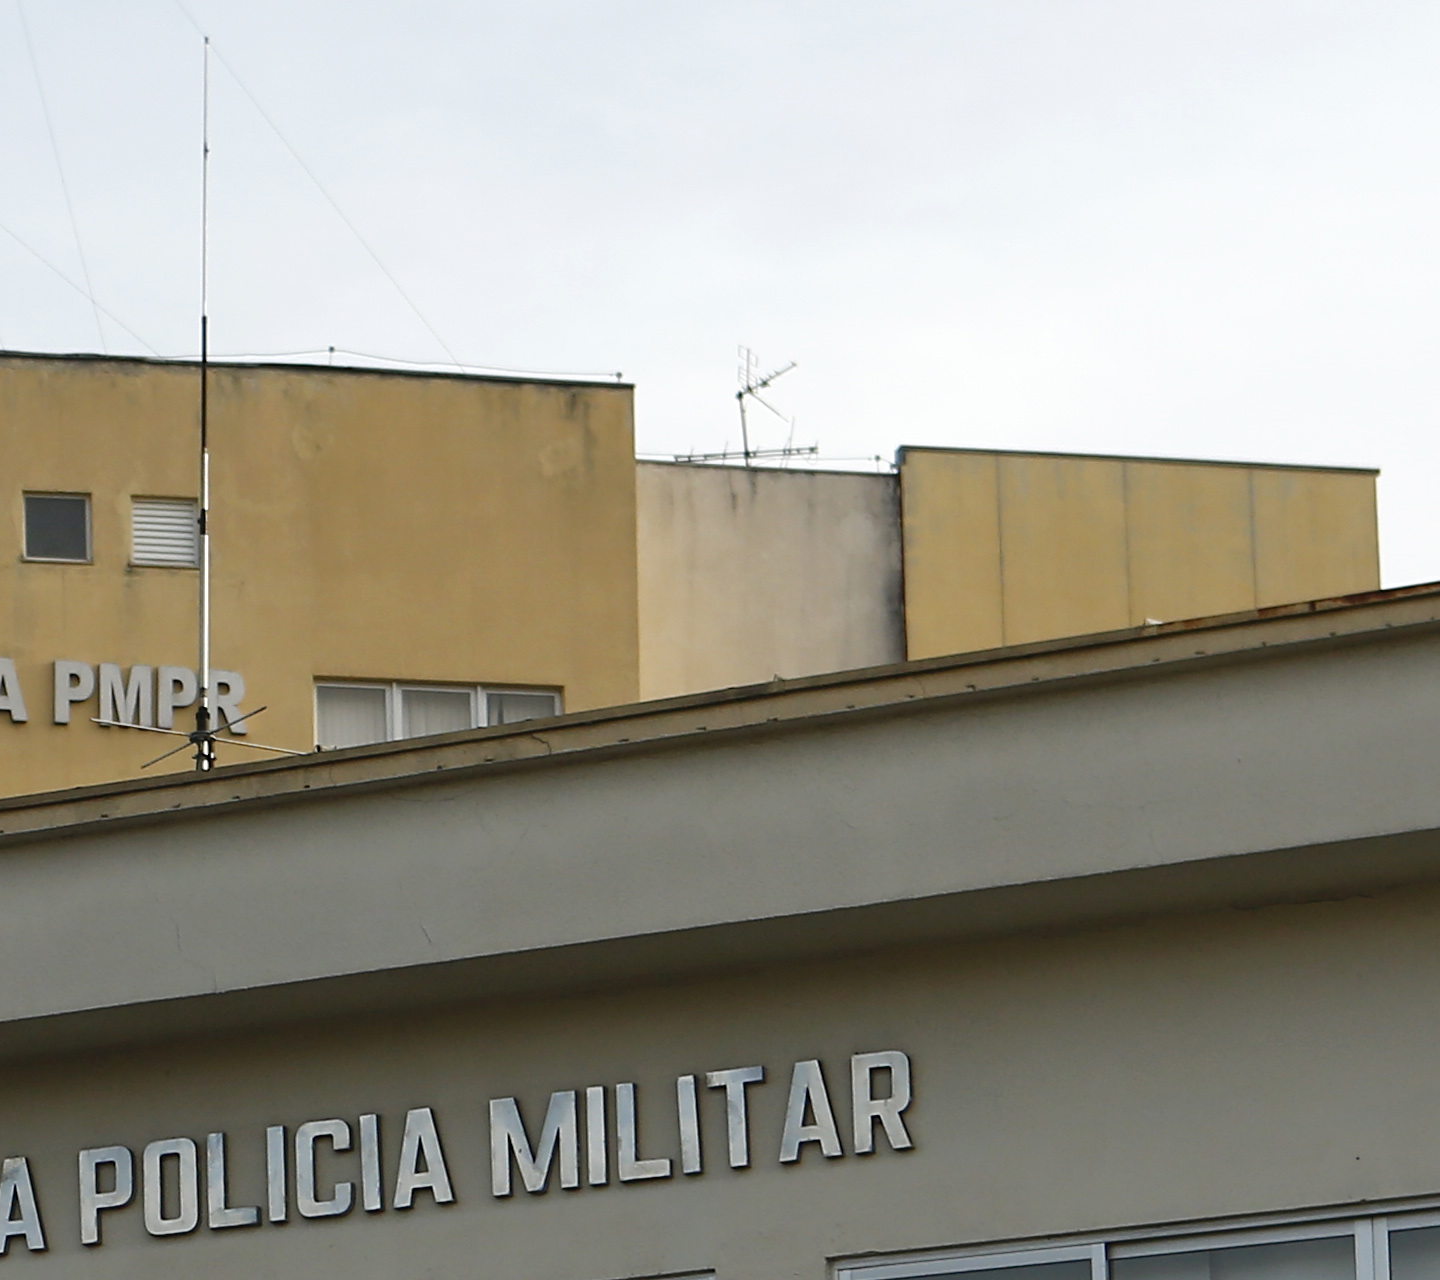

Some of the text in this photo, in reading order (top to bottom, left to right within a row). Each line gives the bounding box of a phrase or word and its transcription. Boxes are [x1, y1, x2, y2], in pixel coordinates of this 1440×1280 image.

[52, 659, 248, 735] PMPR
[77, 1106, 455, 1249] POLICIA
[487, 1049, 915, 1197] MILITAR
